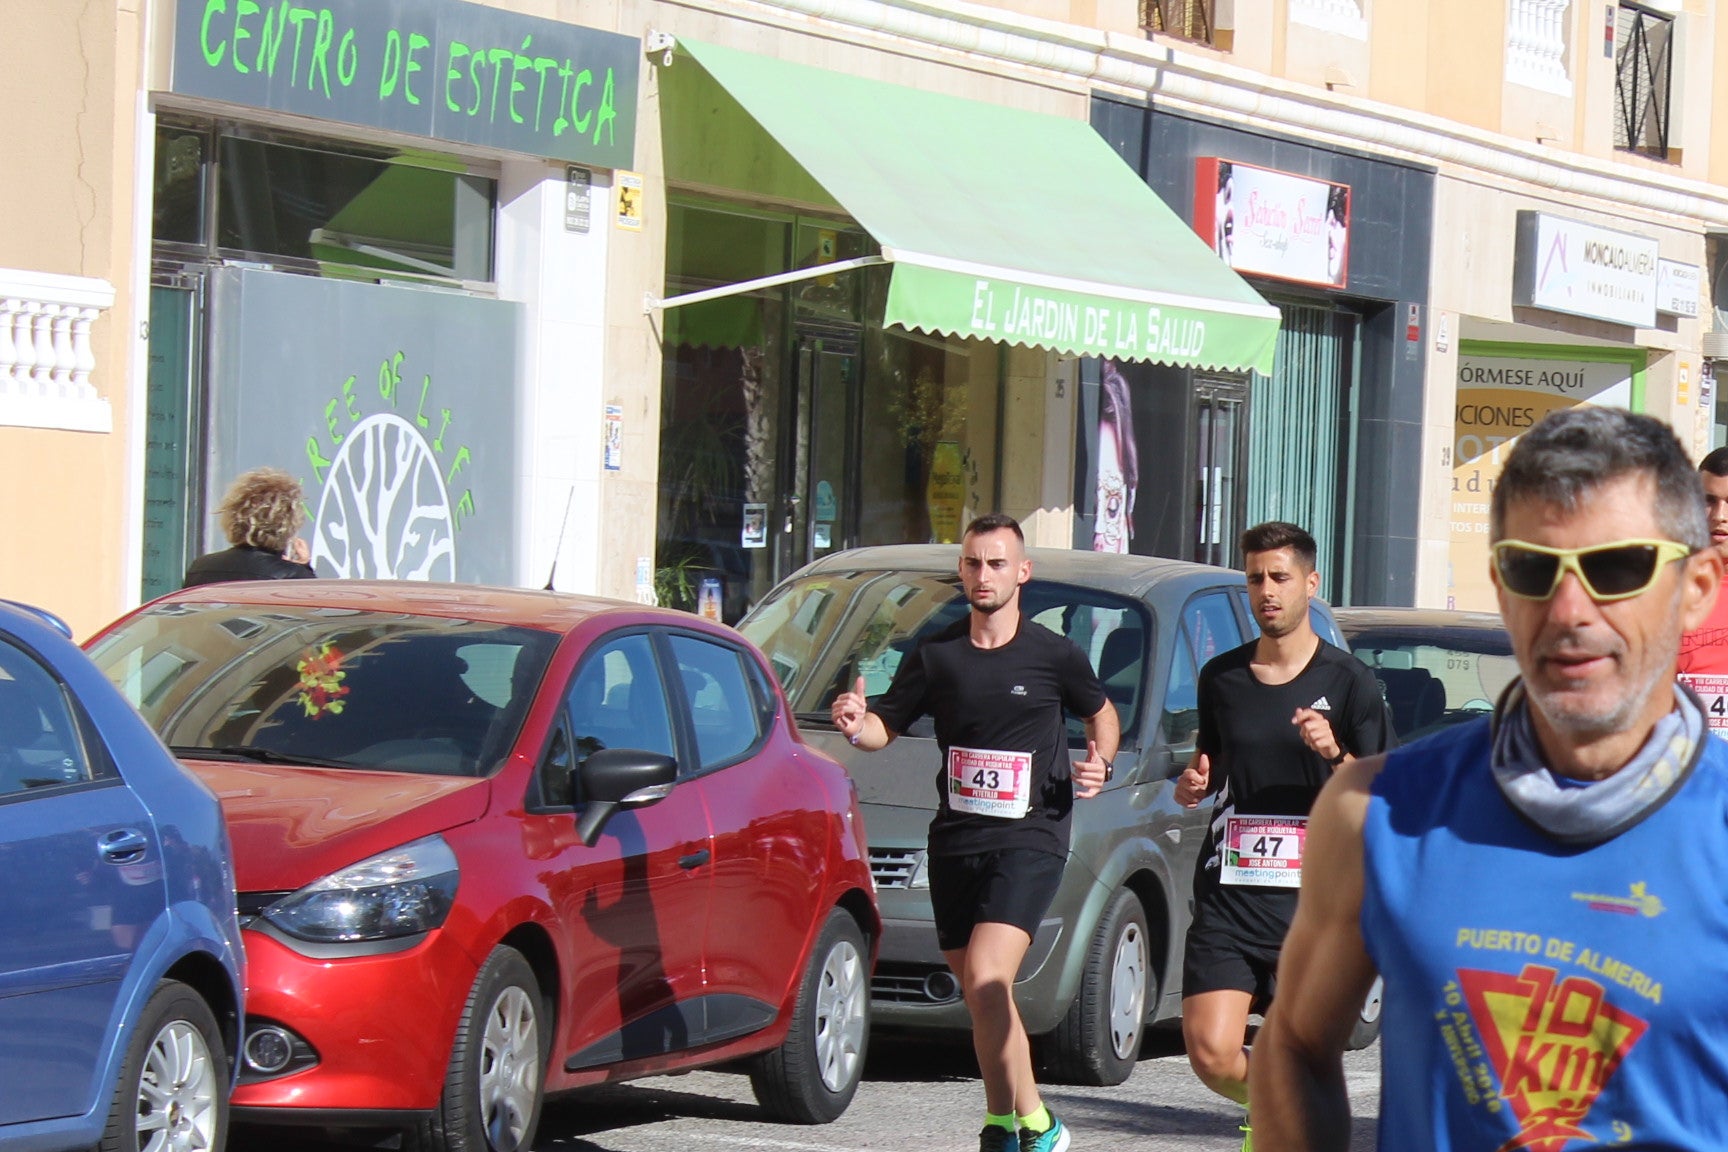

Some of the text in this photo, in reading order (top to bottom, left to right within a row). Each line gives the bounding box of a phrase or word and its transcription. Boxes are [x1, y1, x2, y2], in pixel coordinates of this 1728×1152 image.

[200, 0, 617, 146] CENTRO DE ESTÉTICA
[1457, 362, 1585, 392] ÓRMESE AQUÍ
[378, 351, 404, 408] OF
[417, 374, 475, 531] LIFE
[972, 769, 1000, 789] 43
[1252, 836, 1284, 857] 47
[1456, 927, 1664, 1005] PUERTO DE ALMERIA
[1517, 962, 1606, 1039] 10
